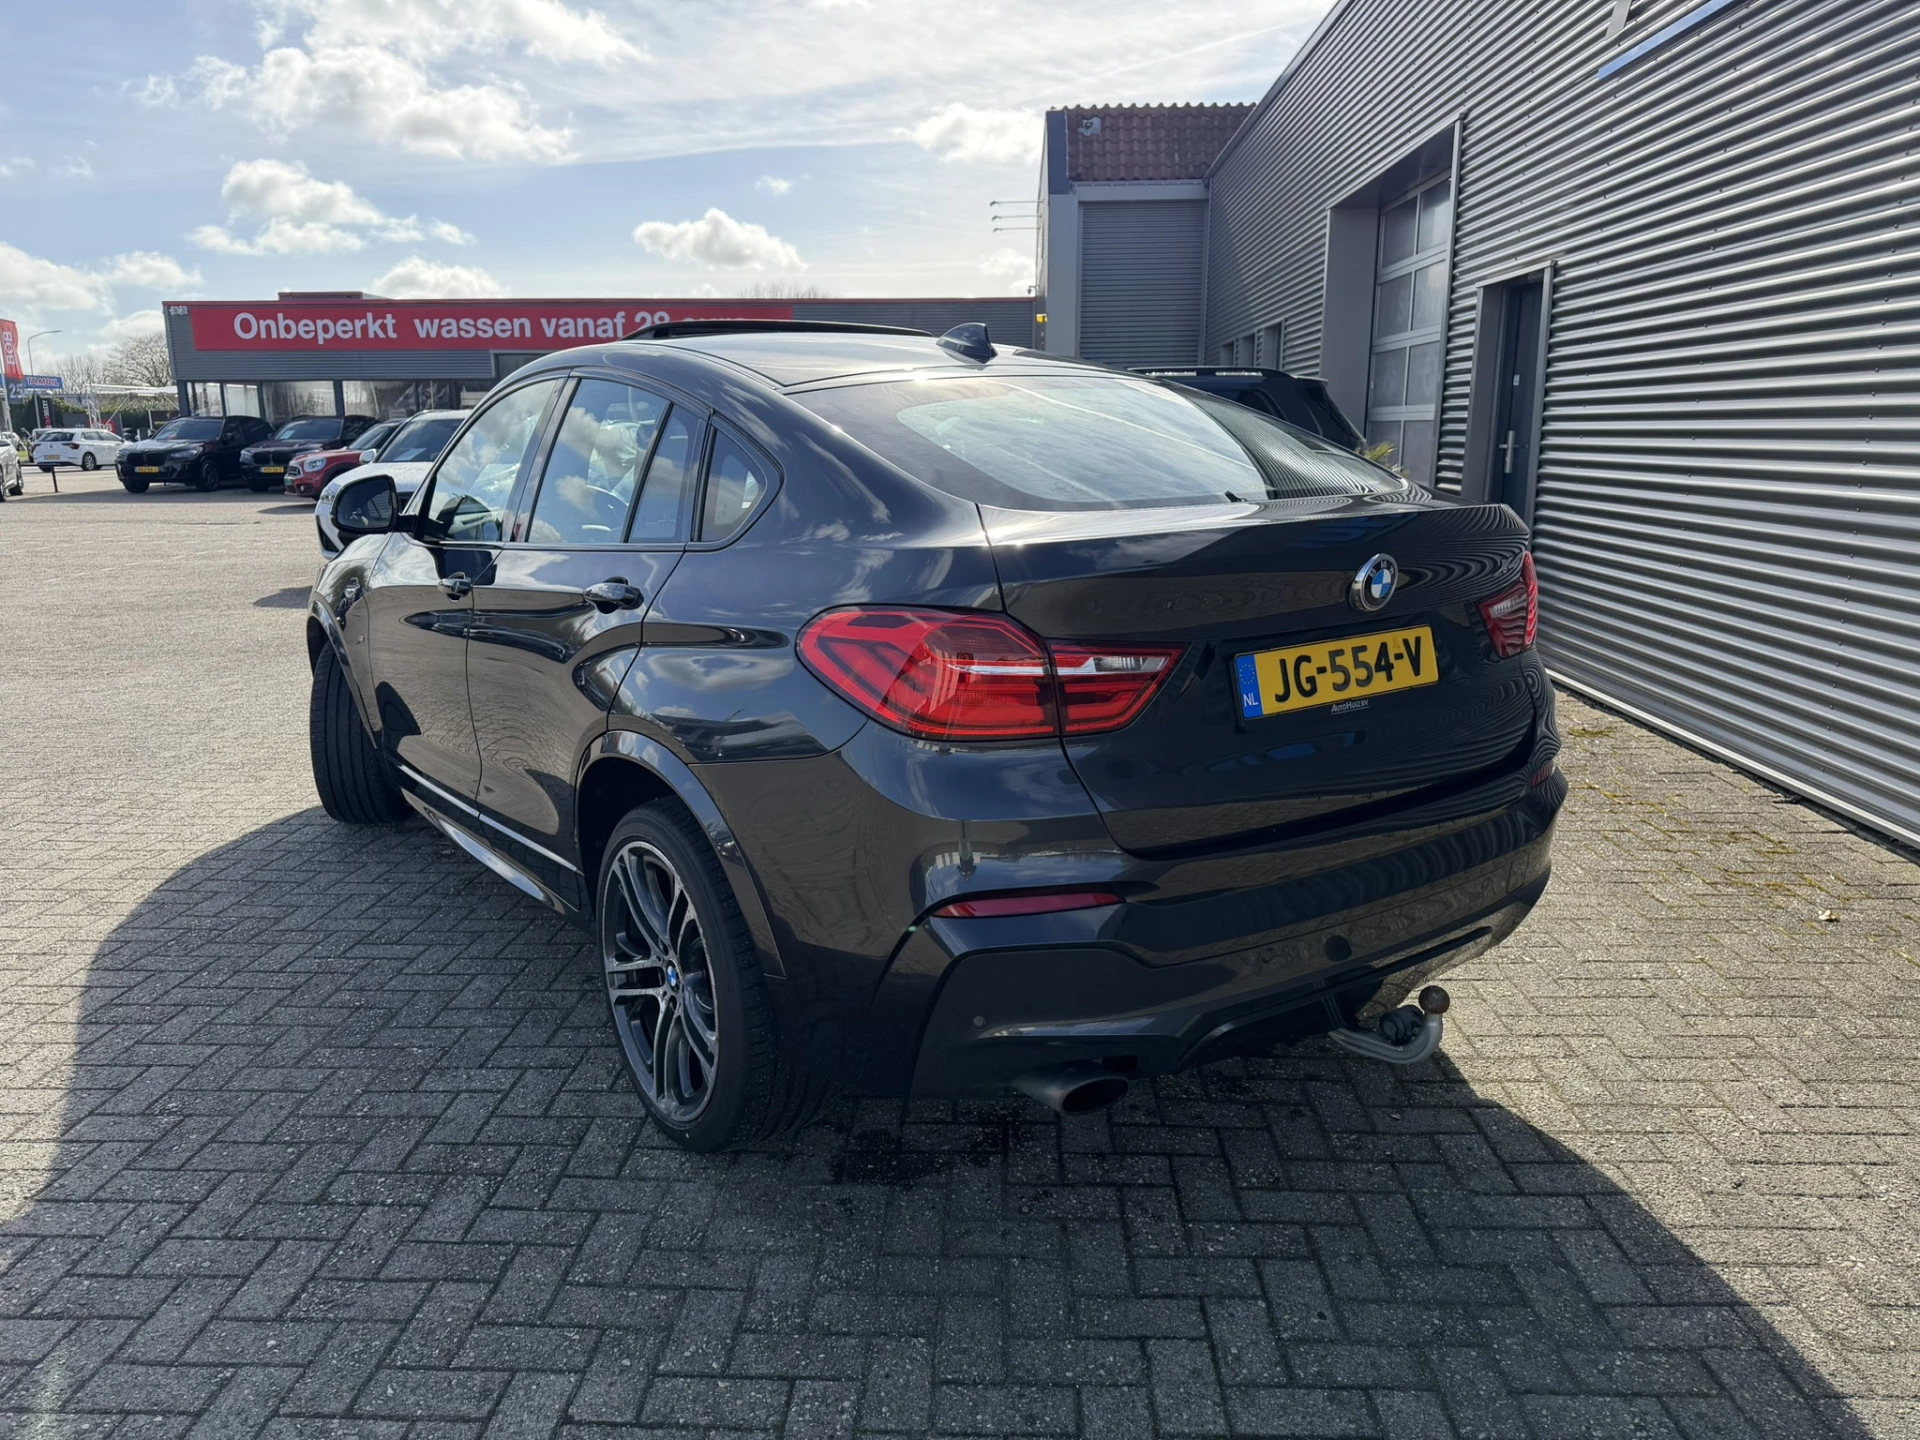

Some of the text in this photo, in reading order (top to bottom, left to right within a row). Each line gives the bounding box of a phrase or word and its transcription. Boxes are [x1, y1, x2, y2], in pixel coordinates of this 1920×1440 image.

[233, 312, 398, 345] Onbeperkt
[413, 317, 531, 339] wassen
[540, 311, 626, 339] vanaf
[1275, 636, 1421, 703] JG-554-V
[1243, 693, 1259, 707] NL
